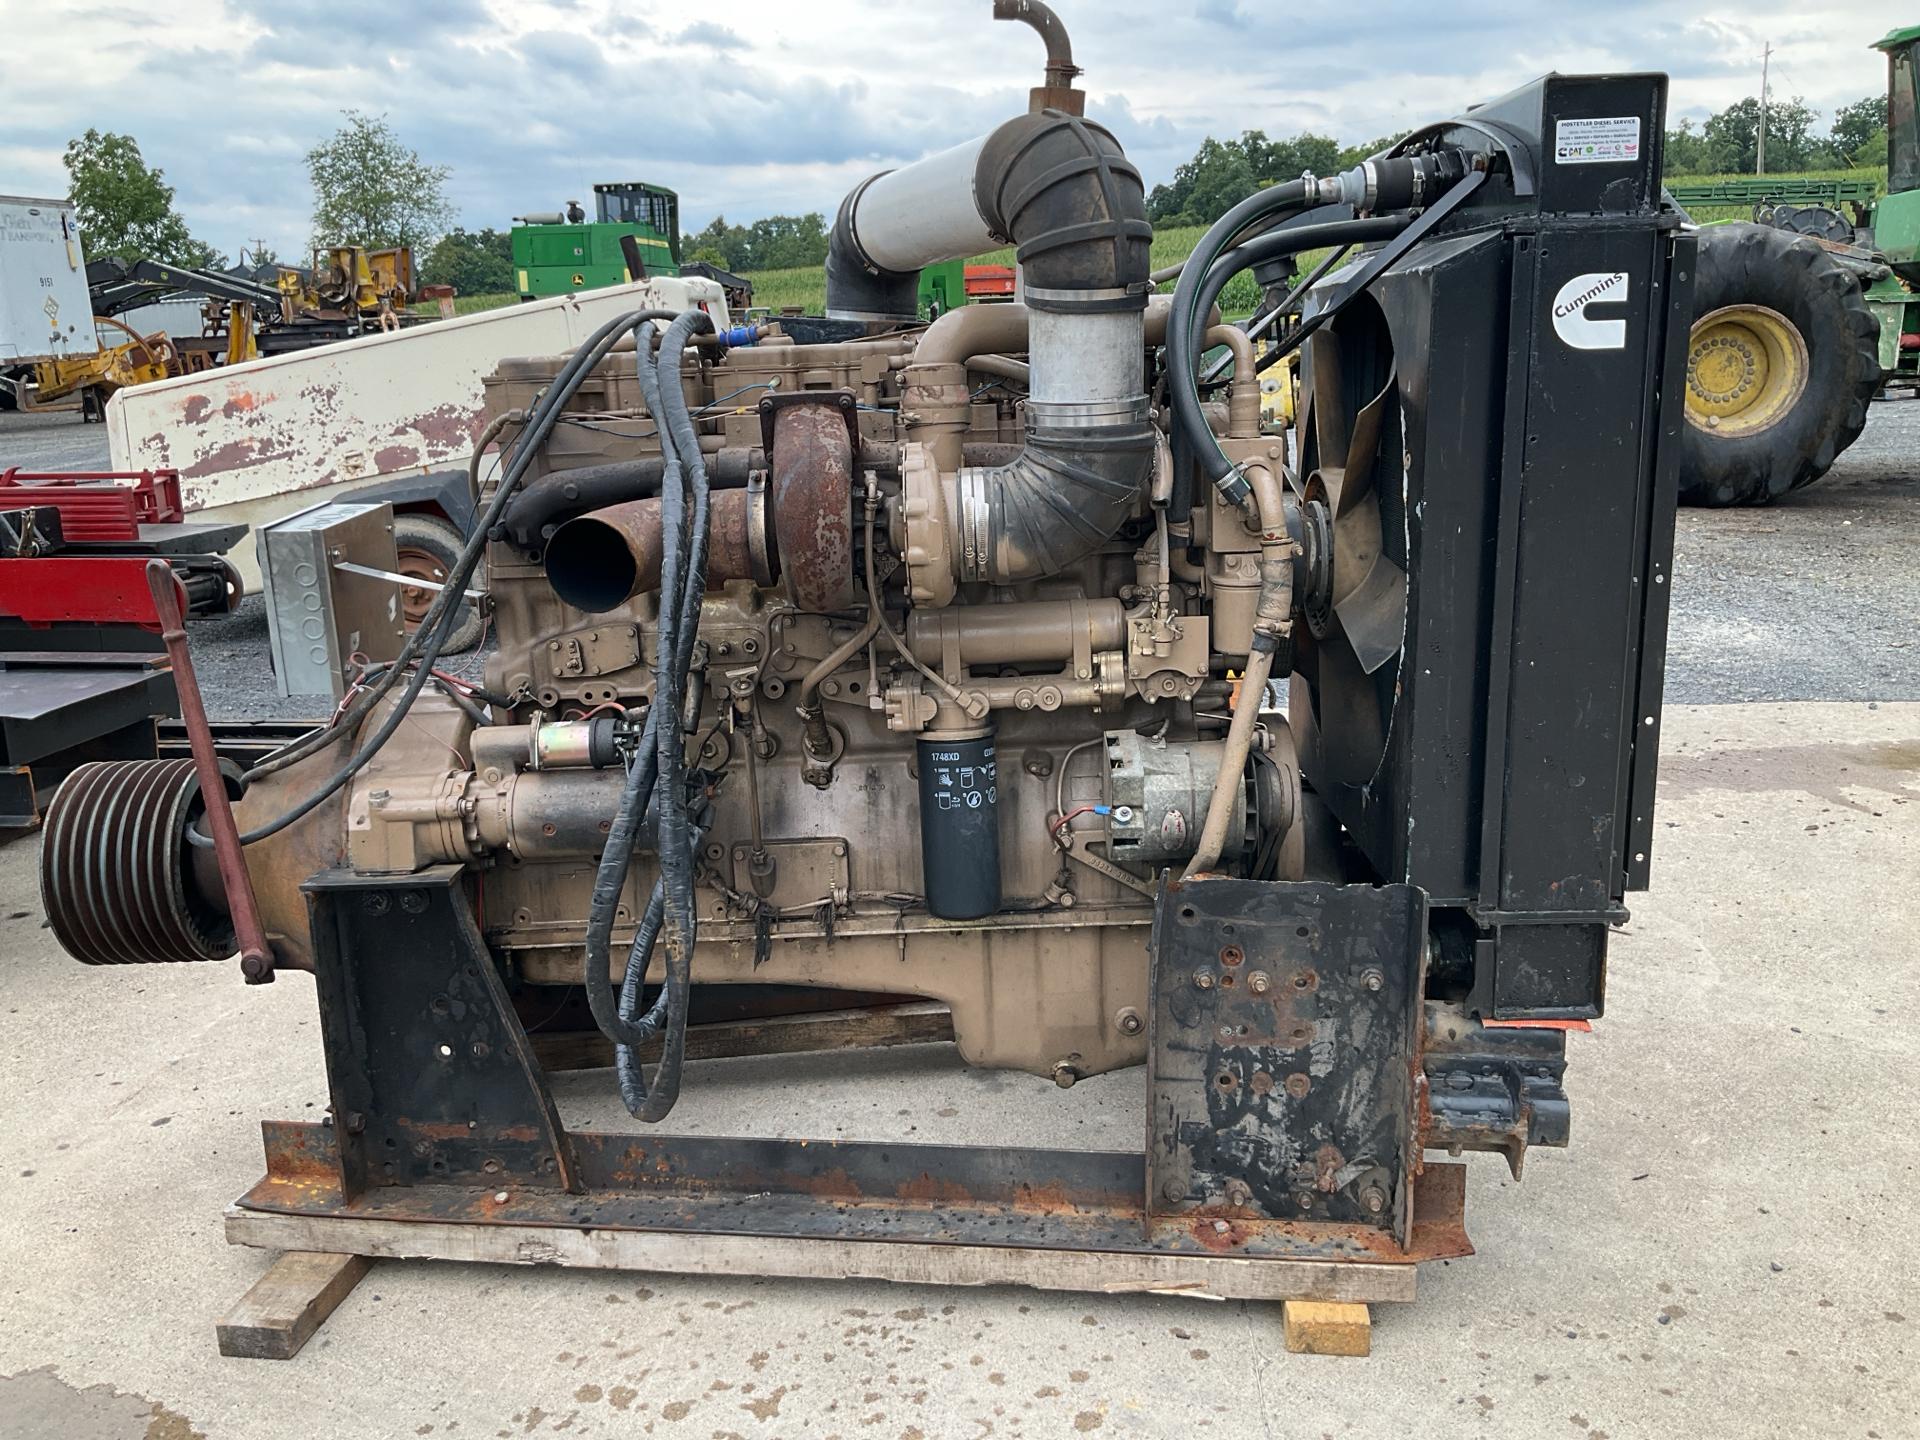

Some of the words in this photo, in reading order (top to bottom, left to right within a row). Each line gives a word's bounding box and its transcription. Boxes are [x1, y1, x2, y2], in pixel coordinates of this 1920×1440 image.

[1568, 147, 1583, 157] CAT
[40, 277, 54, 288] 9151
[1554, 272, 1623, 318] Cummins
[931, 752, 960, 761] 1748XD
